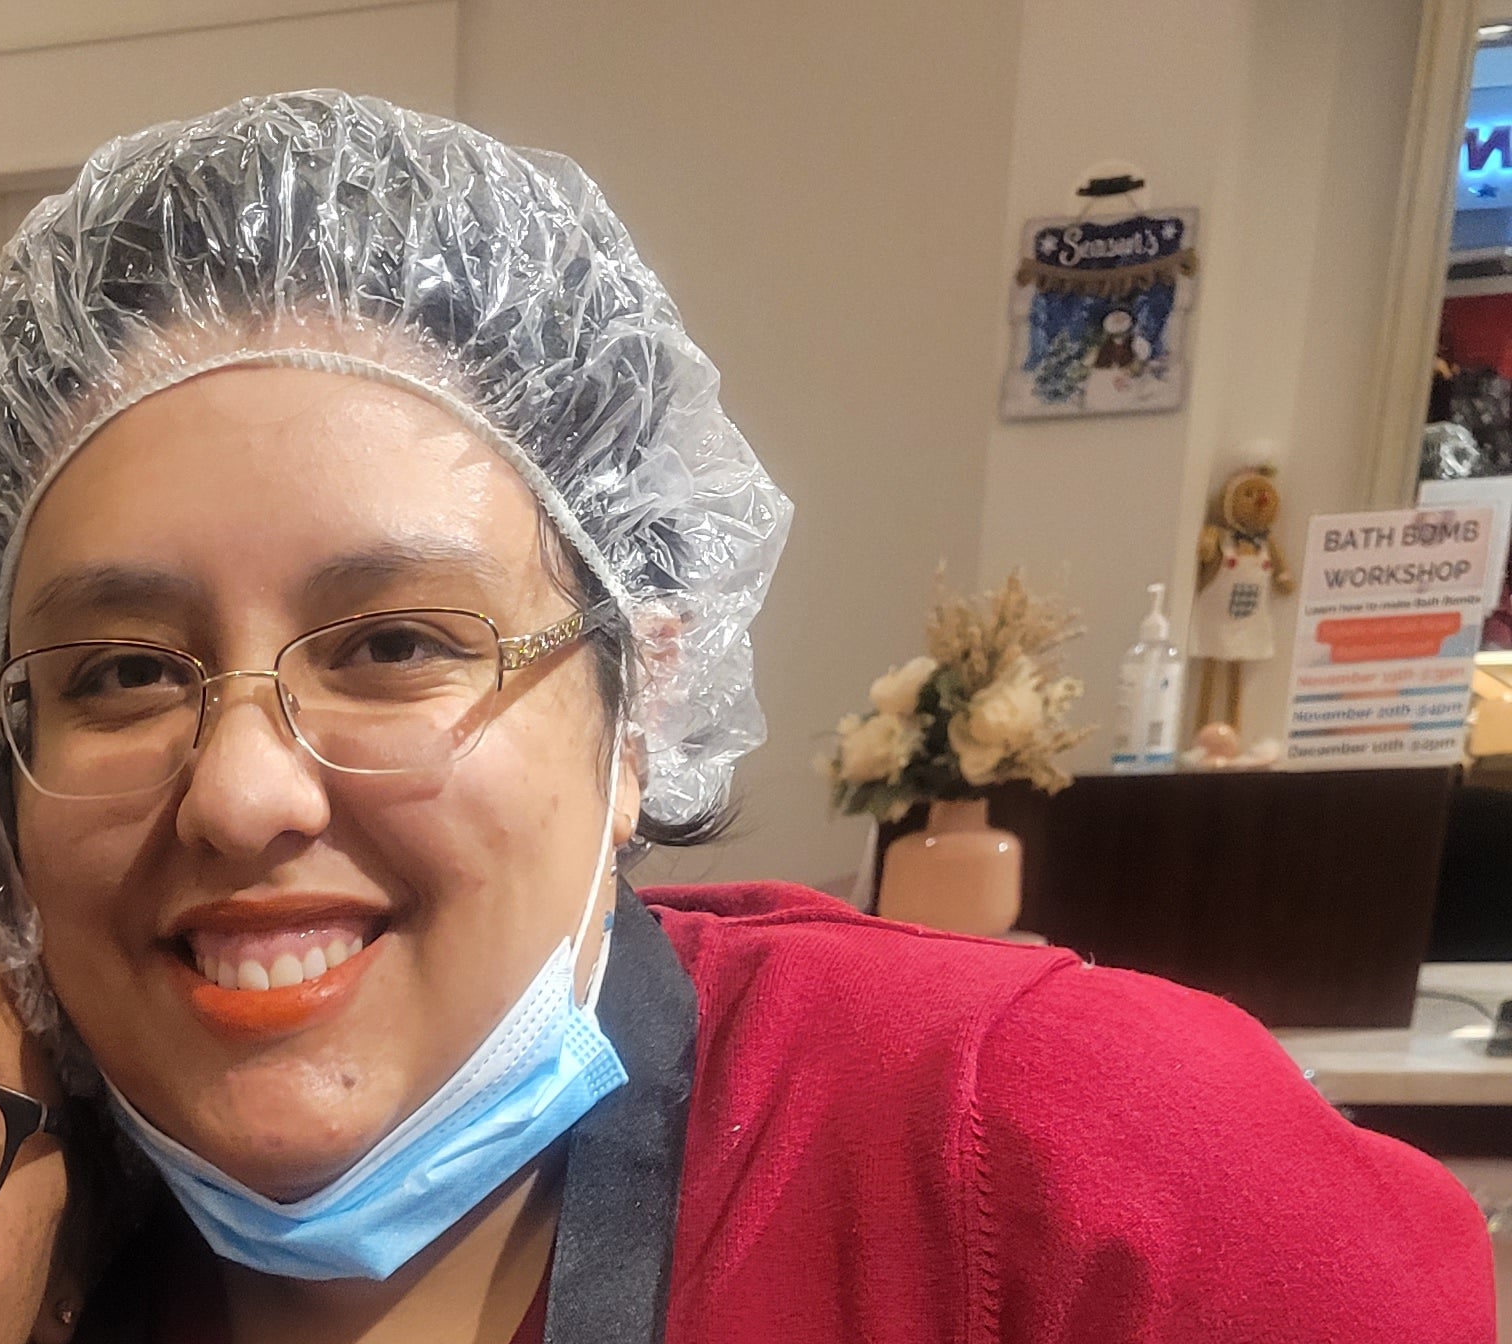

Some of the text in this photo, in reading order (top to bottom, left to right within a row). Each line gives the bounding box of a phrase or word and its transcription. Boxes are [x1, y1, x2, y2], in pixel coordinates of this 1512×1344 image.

[1323, 519, 1479, 552] BATH BOMB
[1323, 560, 1472, 589] WORKSHOP
